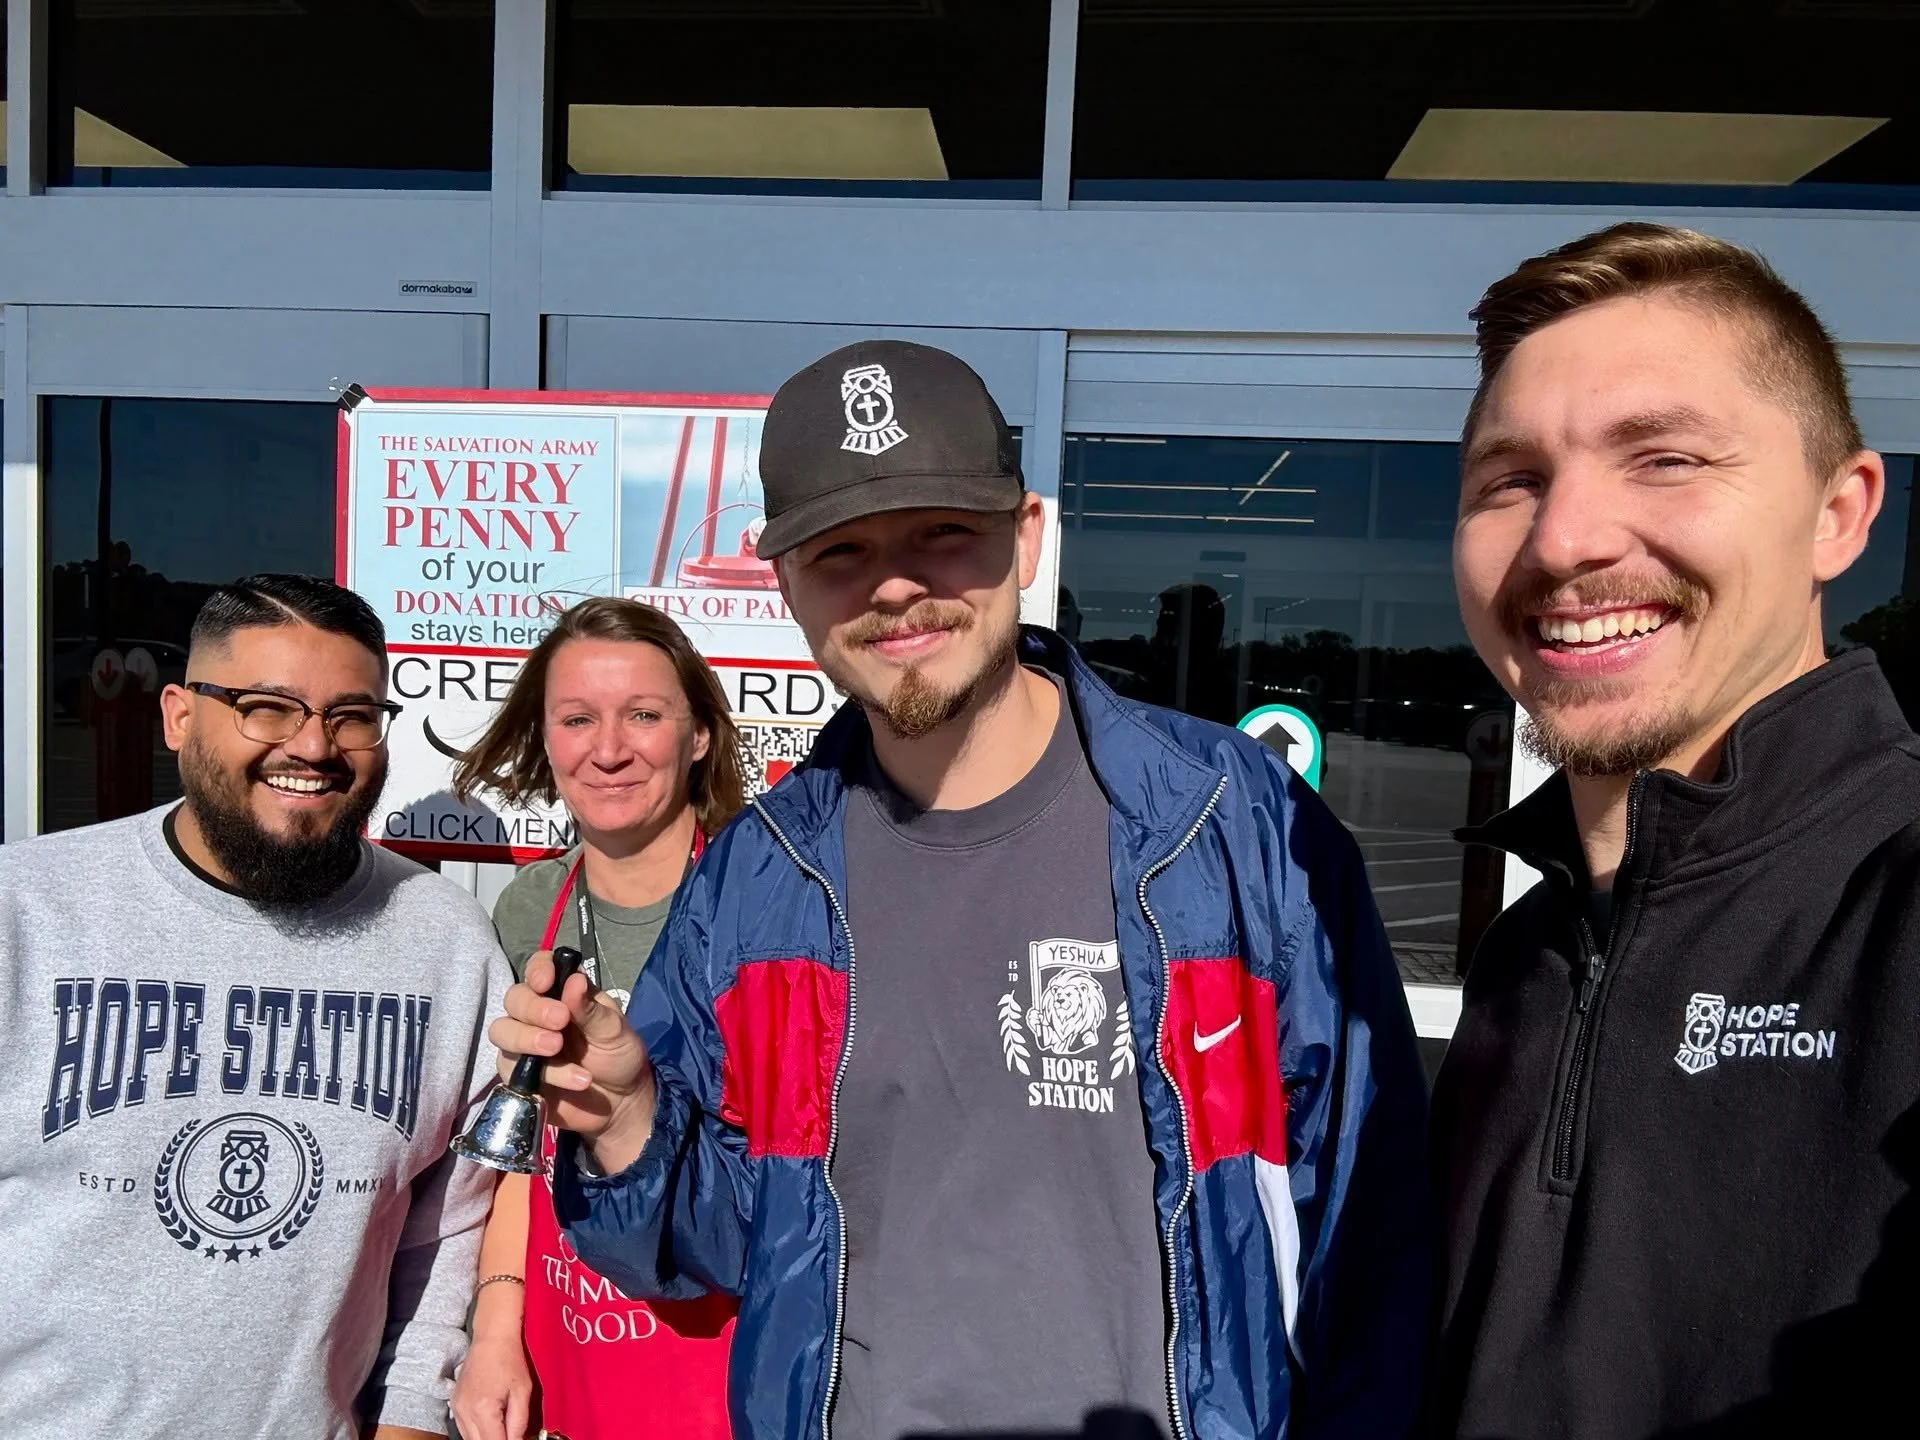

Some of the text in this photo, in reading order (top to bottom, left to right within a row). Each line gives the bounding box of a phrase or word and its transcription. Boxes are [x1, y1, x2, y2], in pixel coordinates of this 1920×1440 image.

[402, 284, 462, 294] dormakaba
[378, 435, 599, 456] THE SALVATION ARMY
[383, 458, 583, 505] EVERY
[382, 505, 581, 553] PENNY
[421, 552, 545, 589] of your
[702, 597, 738, 618] OF
[411, 619, 483, 646] stays
[385, 811, 484, 842] CLICK
[1049, 944, 1106, 965] YESHUA
[1726, 1003, 1800, 1029] HOPE
[1720, 1029, 1836, 1060] STATION
[42, 977, 432, 1142] HOPE STATION
[1042, 1057, 1099, 1085] HOPE
[1028, 1082, 1114, 1113] STATION
[79, 1171, 136, 1194] ESTD
